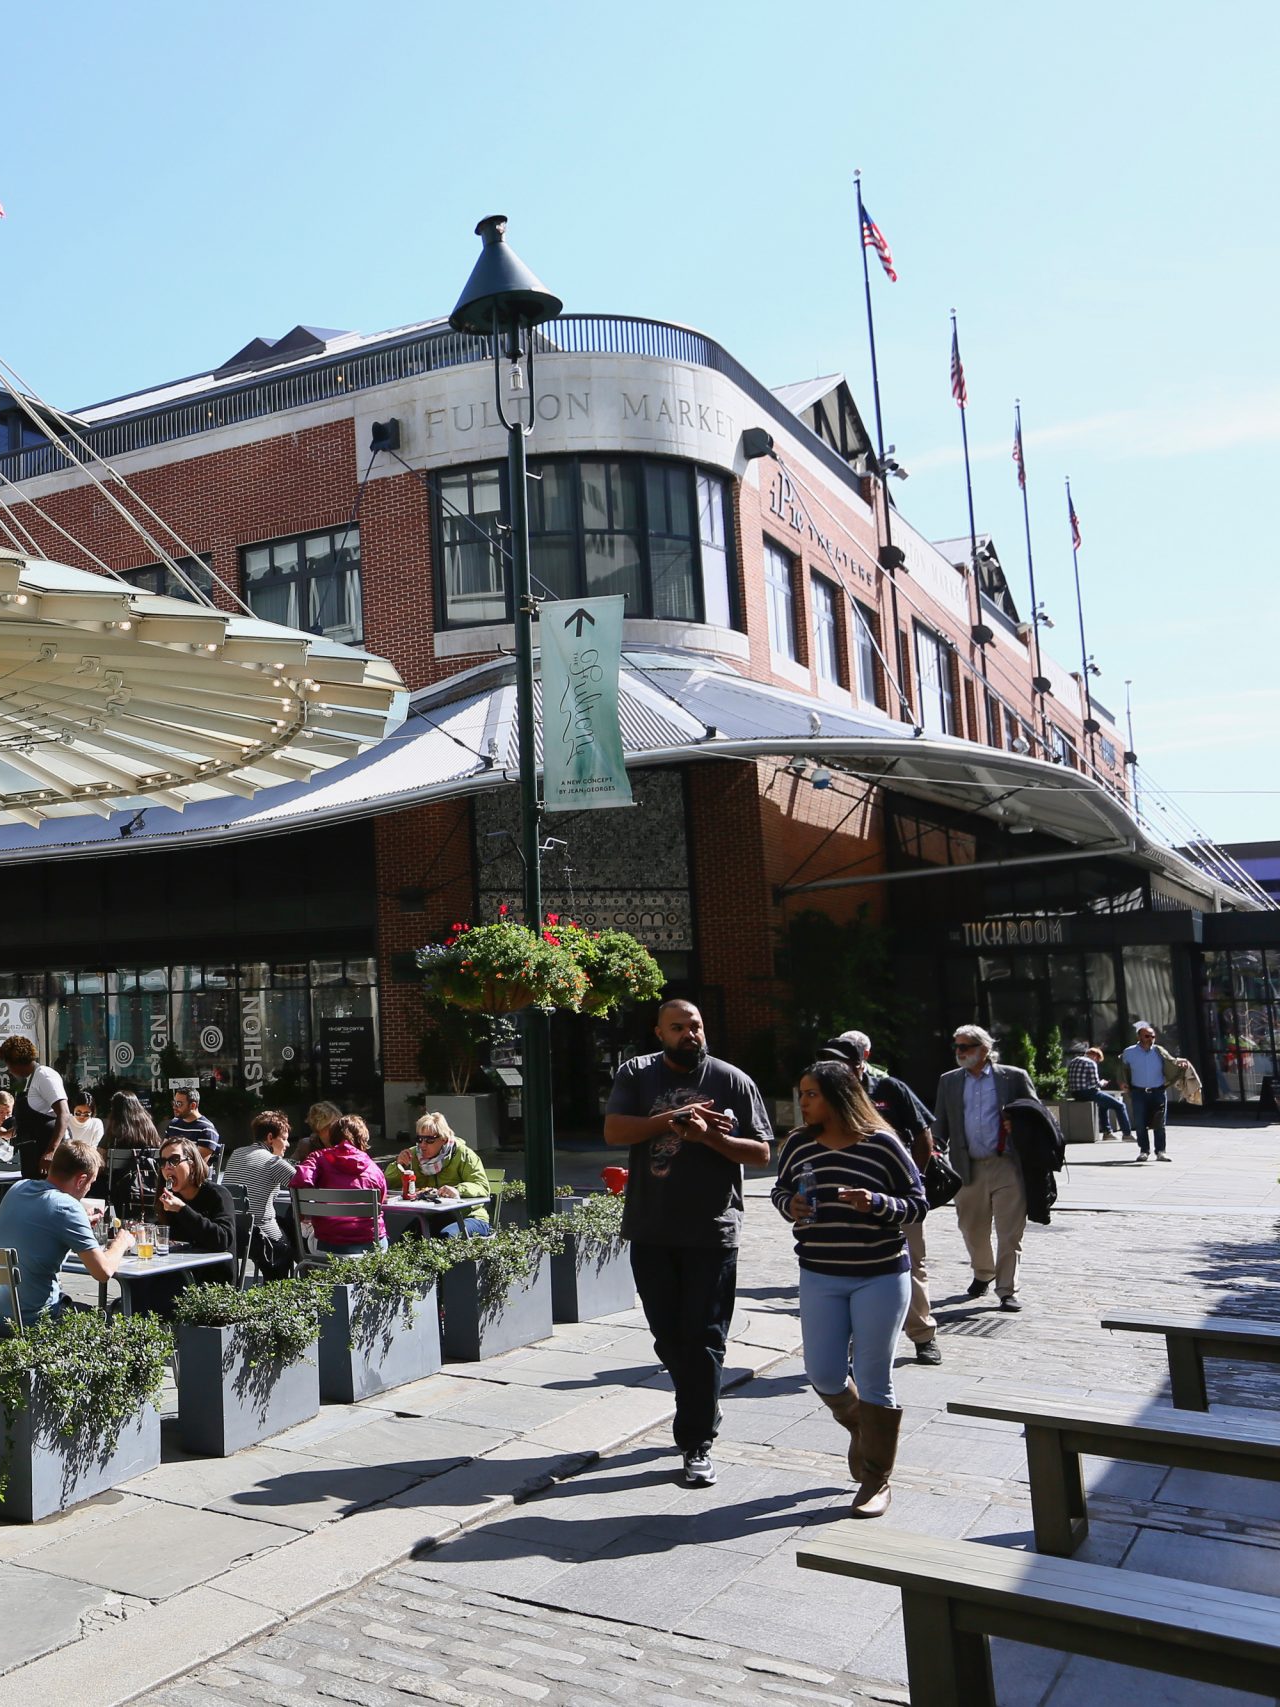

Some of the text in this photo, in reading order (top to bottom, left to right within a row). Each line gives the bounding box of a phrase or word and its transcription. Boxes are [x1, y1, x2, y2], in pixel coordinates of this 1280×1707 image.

[424, 392, 735, 443] FULTON MARKET
[808, 524, 873, 588] THEATERS
[567, 785, 616, 795] JEAN-GEORGES
[582, 776, 613, 785] CONCEPT
[613, 911, 679, 926] como
[962, 921, 1003, 946] TUCK
[1006, 919, 1063, 944] ROOM
[242, 996, 264, 1098] ASHION
